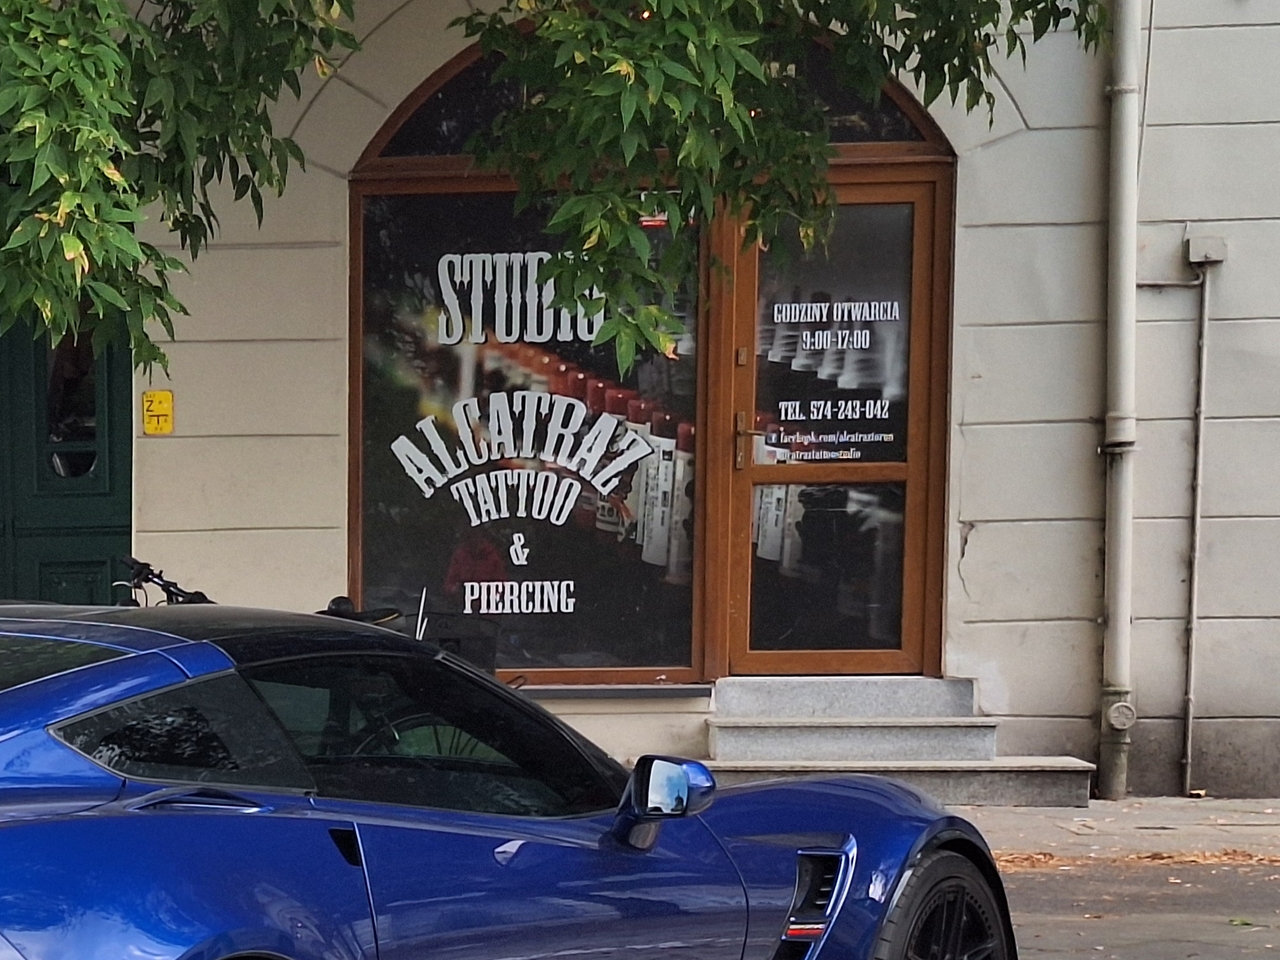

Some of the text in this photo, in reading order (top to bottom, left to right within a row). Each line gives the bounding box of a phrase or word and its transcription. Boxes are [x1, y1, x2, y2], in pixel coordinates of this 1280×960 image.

[774, 302, 900, 323] GODZINY OTWARCIA
[802, 330, 870, 350] 9:00-17:00
[779, 400, 889, 420] TEL. 574-243-042
[390, 390, 653, 499] ALCATRAZ
[450, 469, 581, 527] TATTOO
[509, 533, 529, 565] &
[463, 580, 575, 614] PIERCING
